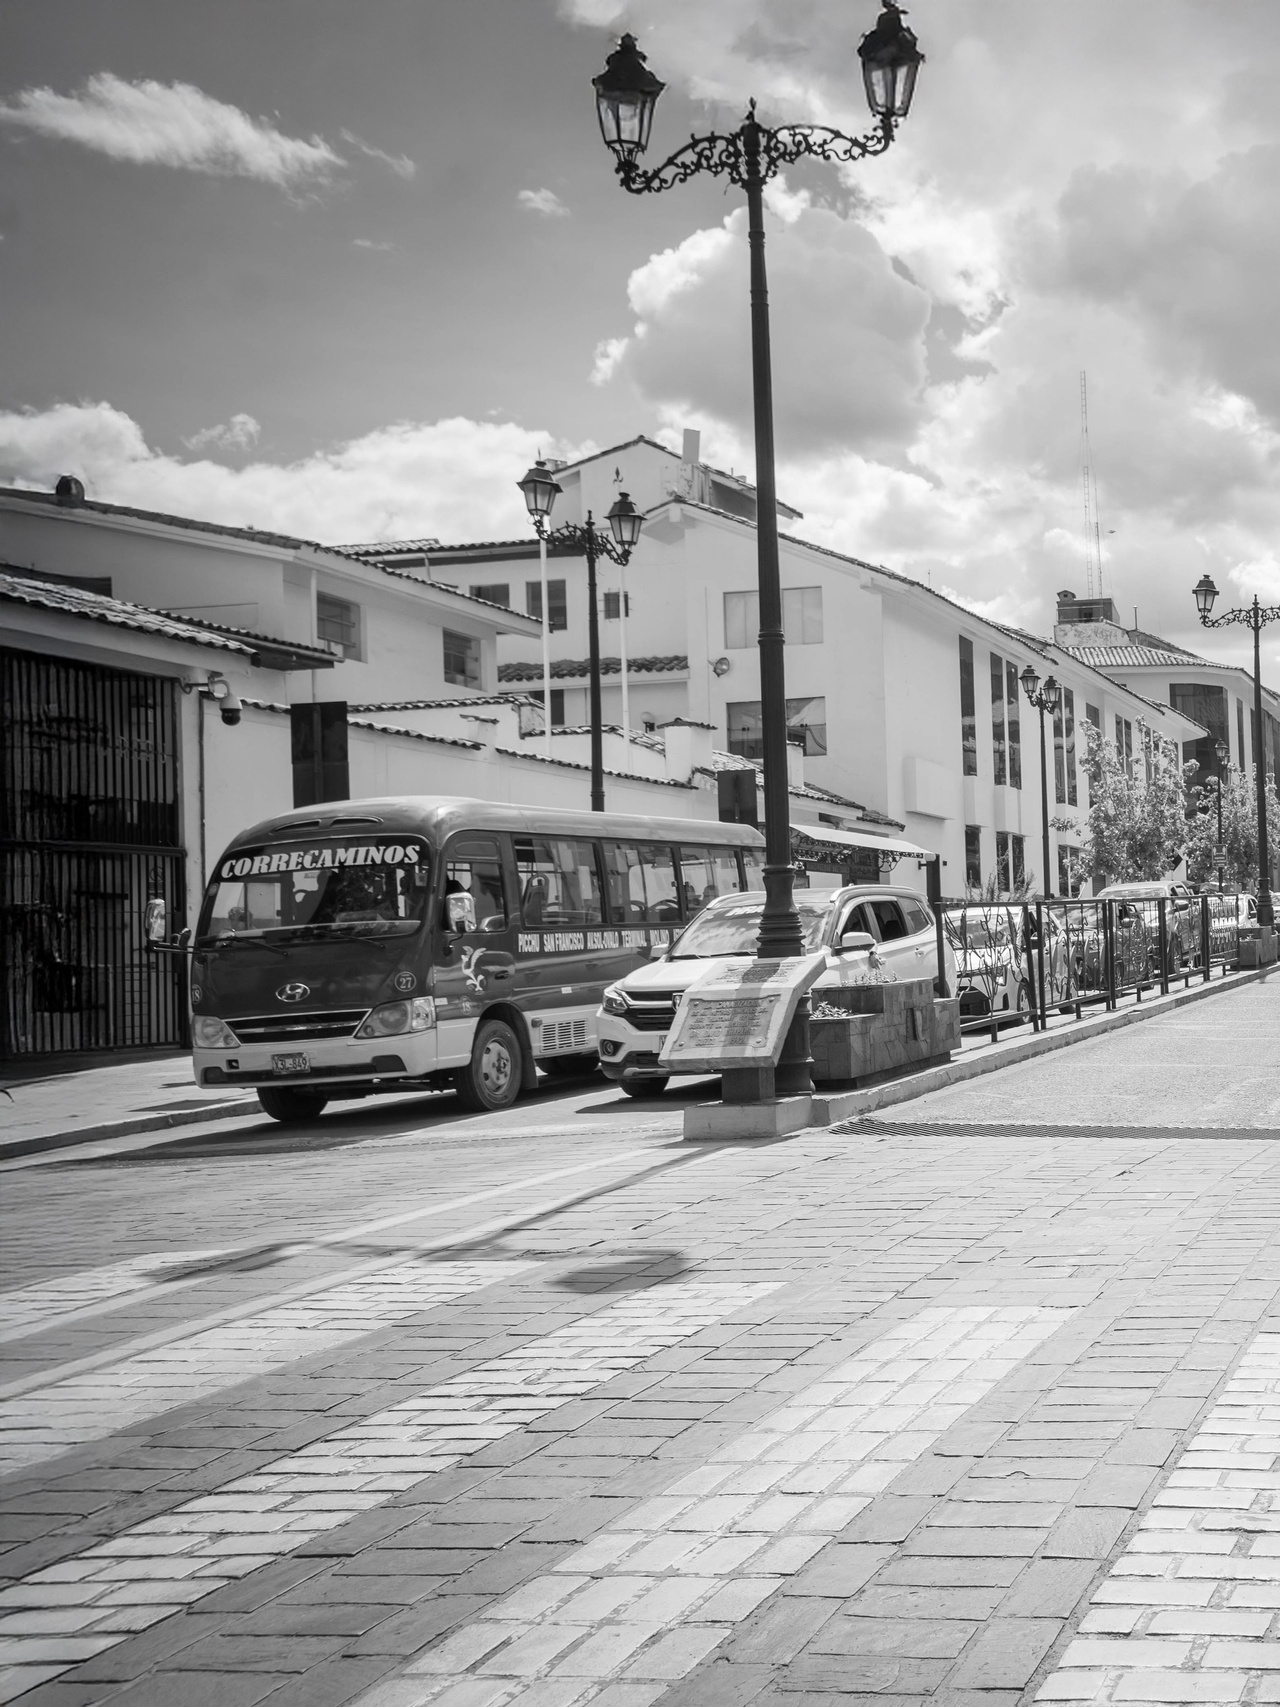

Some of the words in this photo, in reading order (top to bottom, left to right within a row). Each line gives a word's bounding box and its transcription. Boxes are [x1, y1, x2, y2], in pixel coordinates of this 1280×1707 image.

[221, 845, 420, 879] CORRECAMINOS
[518, 933, 540, 952] PICCHU
[543, 933, 555, 952] SAN
[555, 932, 585, 951] FRANCISCO
[621, 930, 648, 948] TERMINAL
[399, 977, 412, 989] 27
